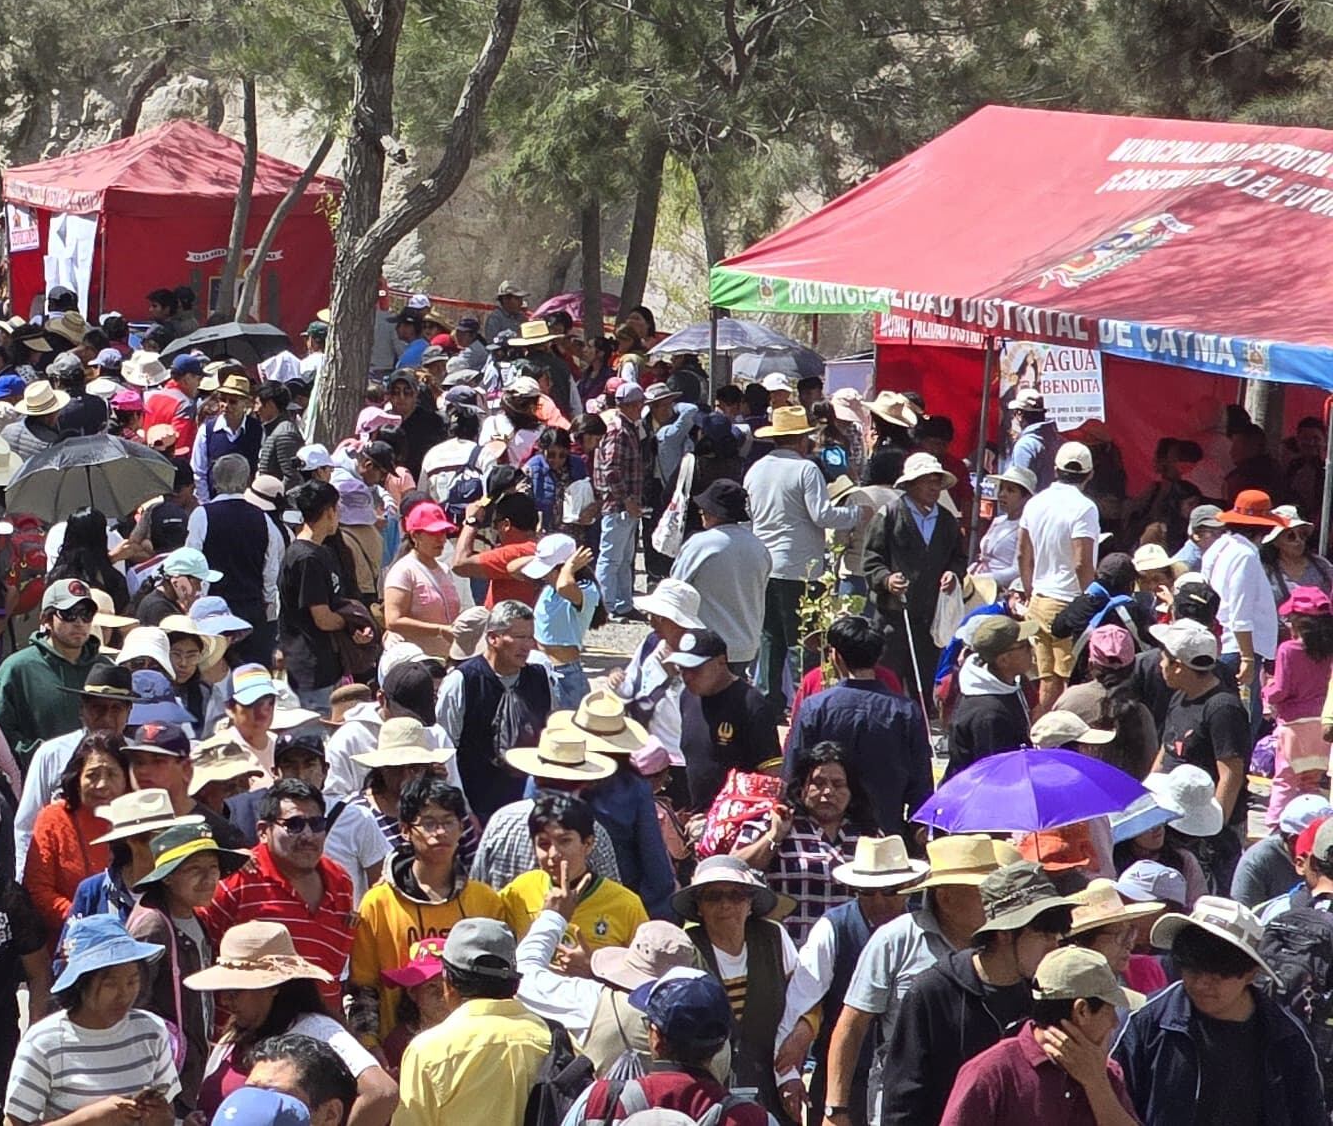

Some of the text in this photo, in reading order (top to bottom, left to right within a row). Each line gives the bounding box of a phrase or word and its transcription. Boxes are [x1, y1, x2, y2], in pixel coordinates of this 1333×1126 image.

[1241, 174, 1283, 199] EL
[788, 278, 1237, 368] MUNICIPALIDAD DISTRITAL DE CAYMA
[1043, 349, 1098, 372] AGUA
[1042, 378, 1101, 394] BENDITA
